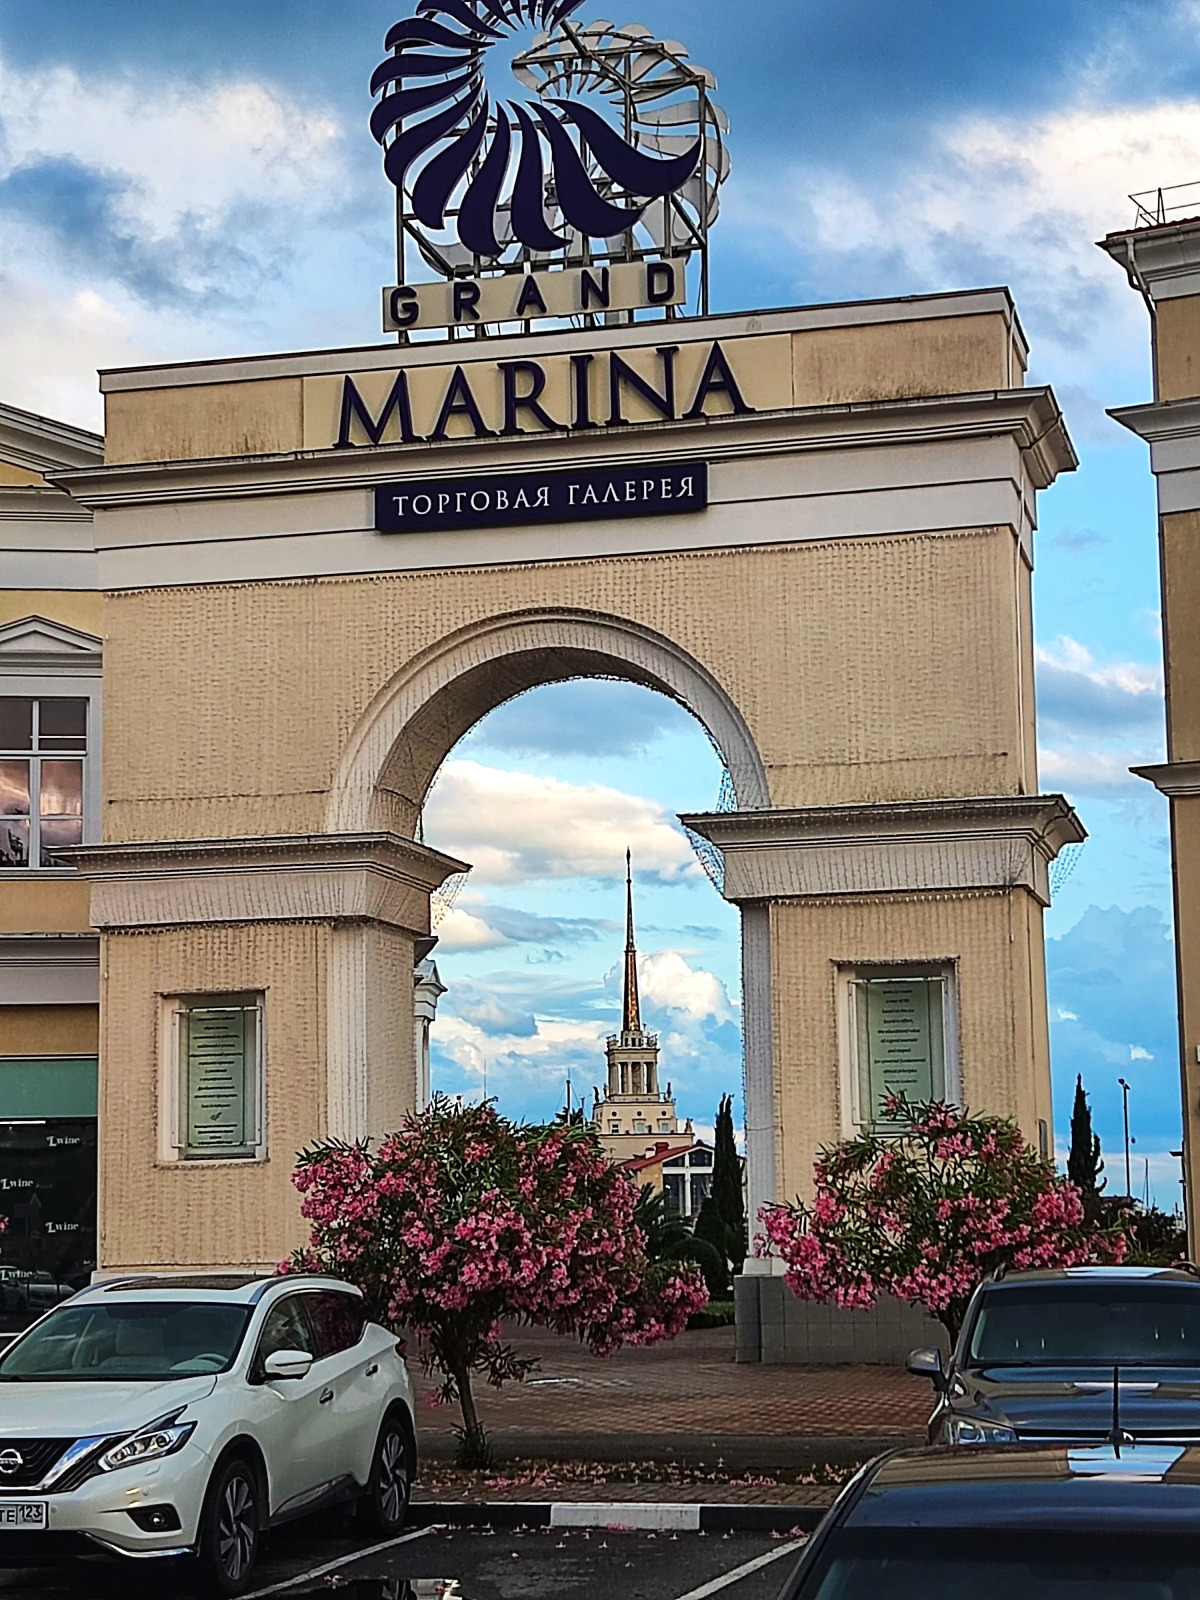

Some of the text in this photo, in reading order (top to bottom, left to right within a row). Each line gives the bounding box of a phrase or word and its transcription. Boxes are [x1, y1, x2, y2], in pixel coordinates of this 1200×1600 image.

[389, 262, 676, 326] GRAND
[332, 340, 756, 449] MARINA
[392, 476, 695, 517] ТОРГОВАЯ ГАЛЕРЕЯ
[19, 1505, 42, 1518] 123
